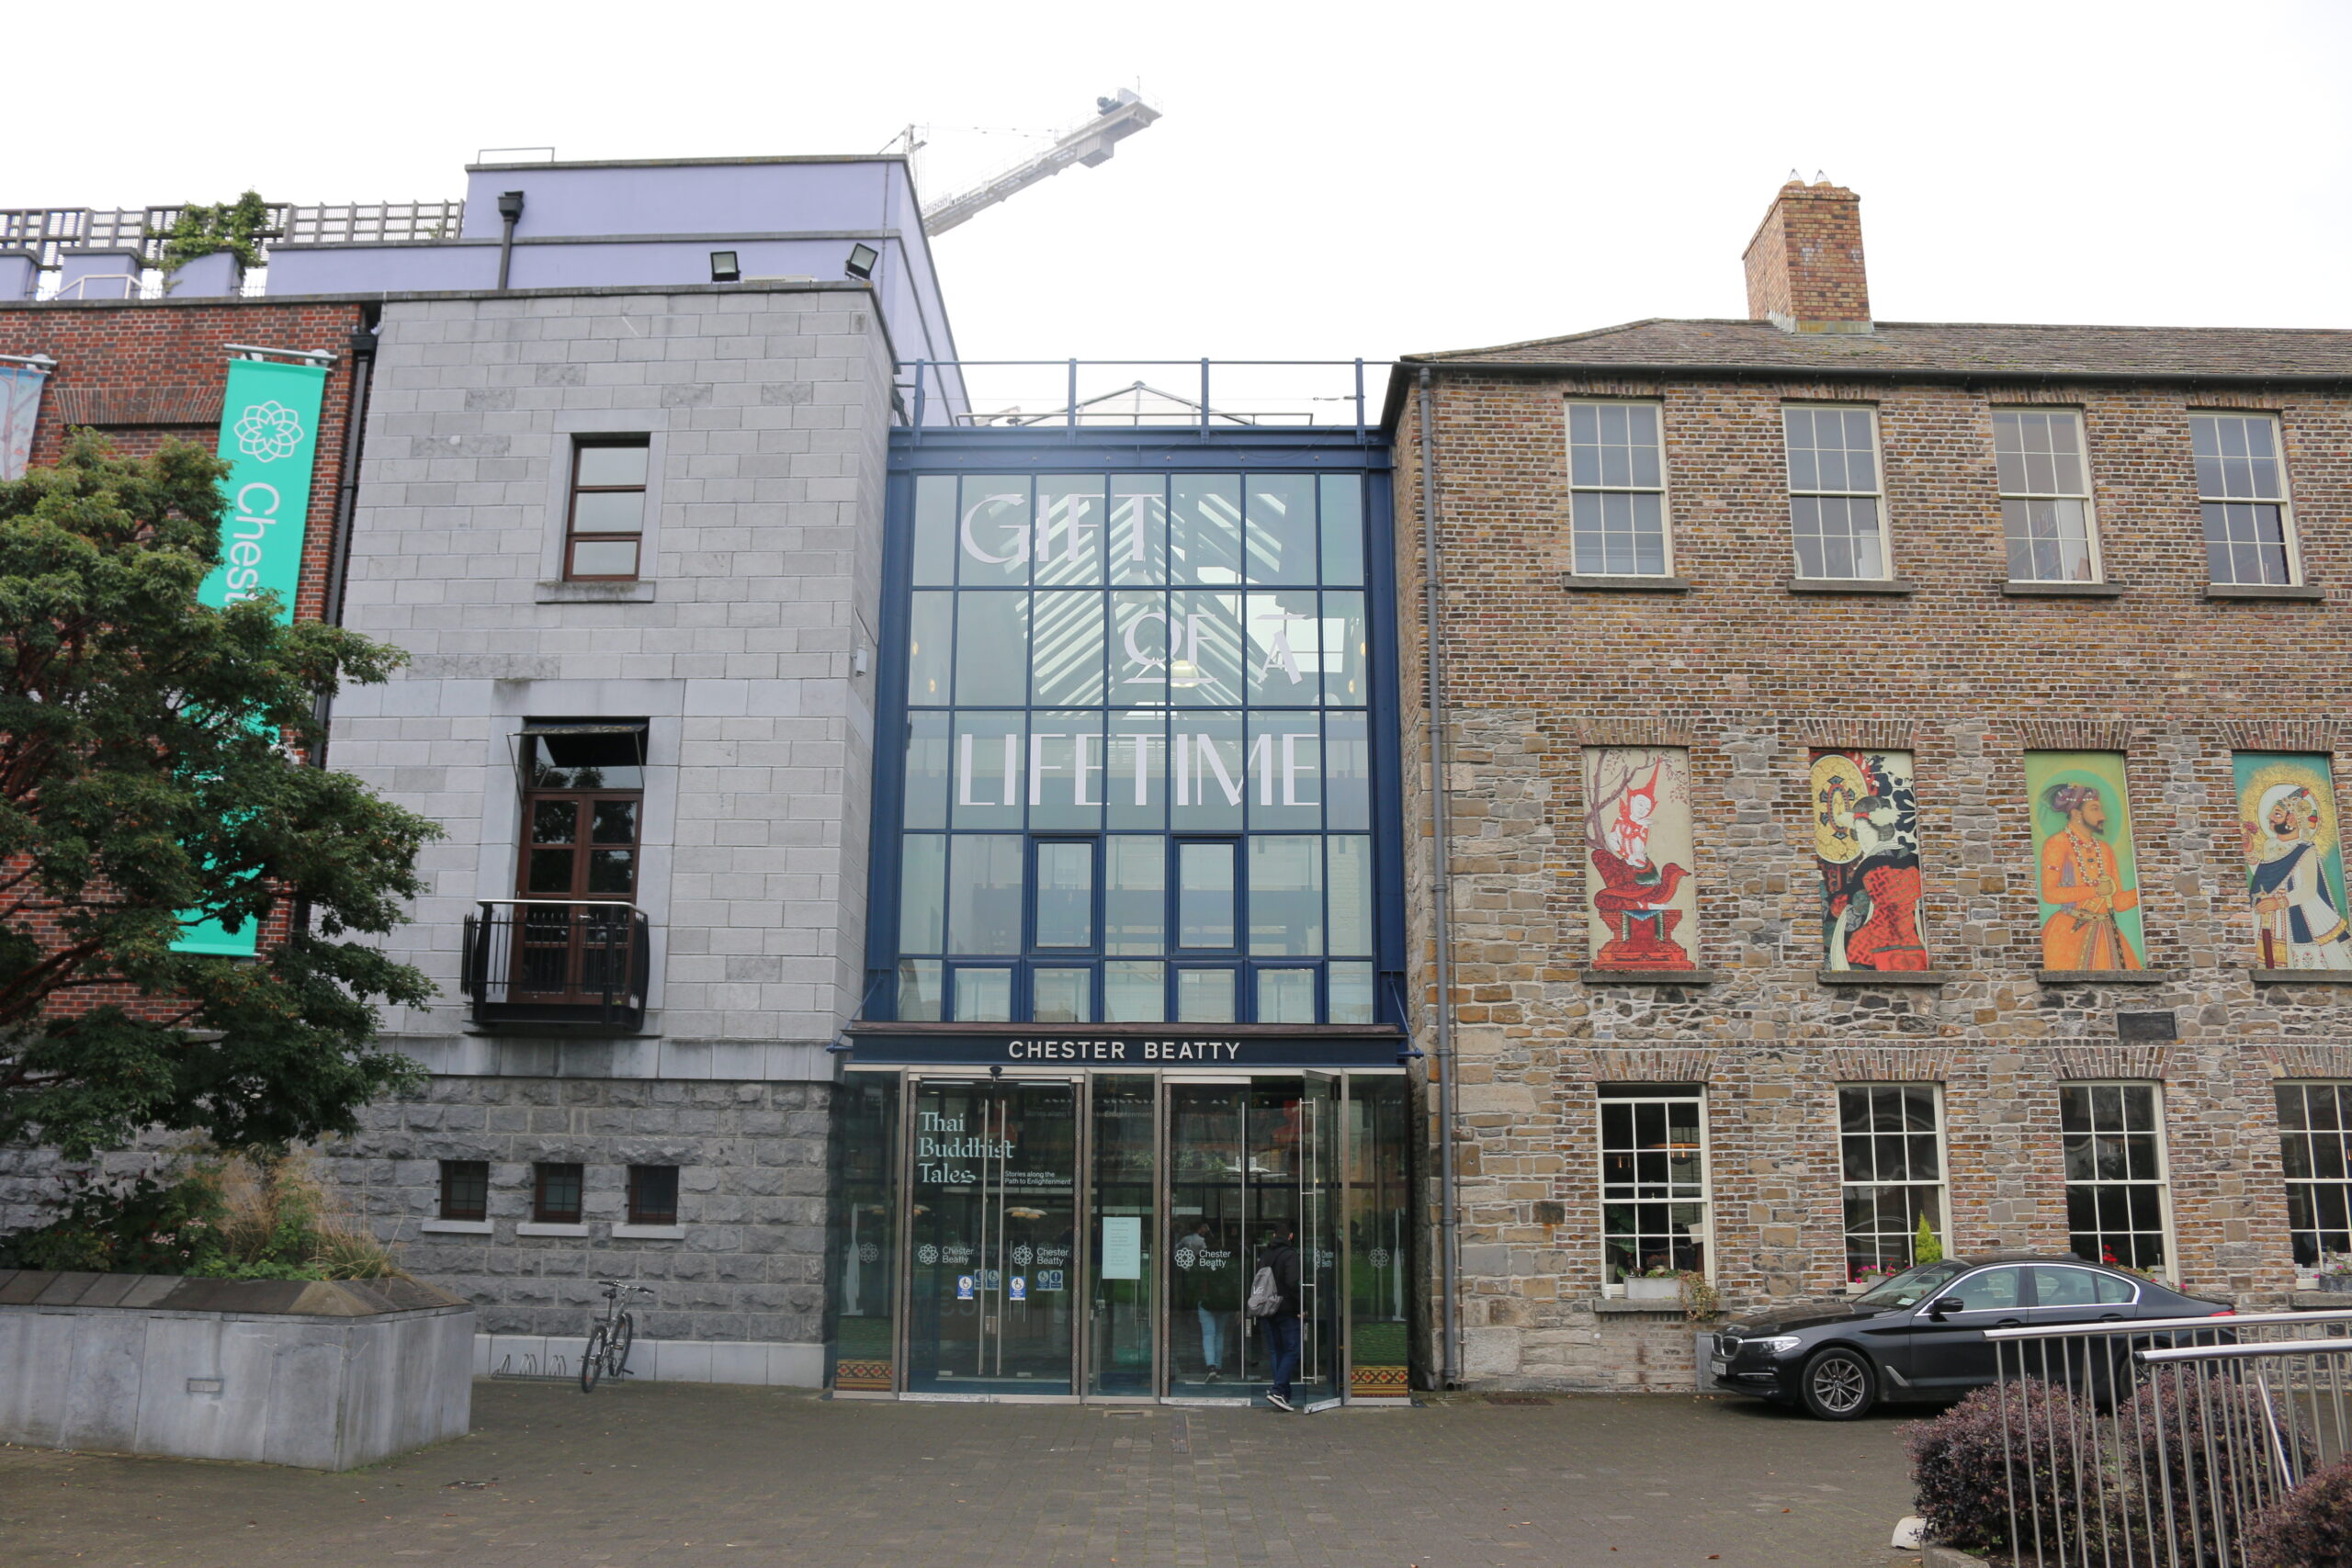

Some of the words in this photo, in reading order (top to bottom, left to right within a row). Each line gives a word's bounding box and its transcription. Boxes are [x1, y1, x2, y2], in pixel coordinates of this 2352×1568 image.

[960, 492, 1162, 564] GIFT
[224, 482, 280, 603] Chest
[1123, 613, 1217, 684] OF
[1255, 614, 1308, 685] A
[959, 733, 1319, 807] LIFETIME
[1008, 1041, 1125, 1058] CHESTER
[1144, 1042, 1240, 1059] BEATTY
[1104, 1109, 1153, 1118] Enlightenment
[919, 1111, 966, 1132] Thai
[918, 1137, 1015, 1158] Buddhist
[919, 1163, 977, 1184] Tales
[1027, 1178, 1071, 1186] Enlightenment
[942, 1246, 975, 1256] Chester
[1036, 1247, 1069, 1257] Chester
[1199, 1249, 1231, 1258] Chester
[942, 1256, 969, 1266] Beatty
[1036, 1257, 1065, 1267] Beatty
[1199, 1258, 1227, 1268] Beatty
